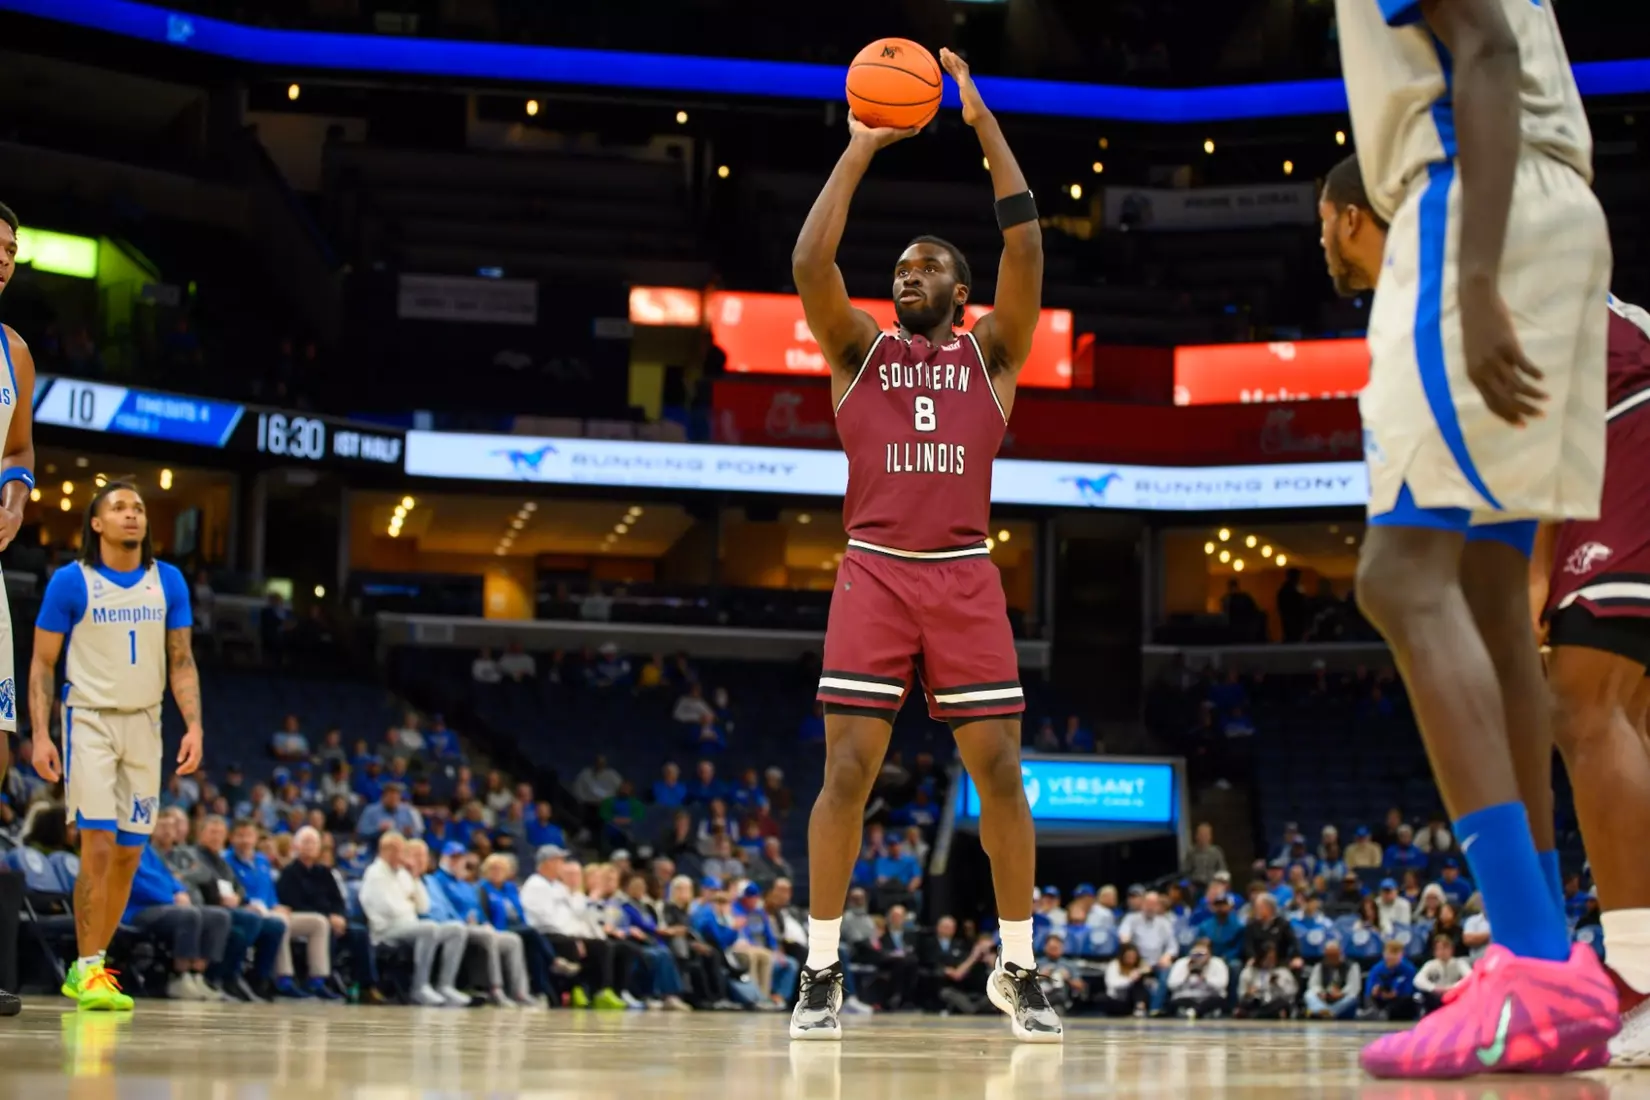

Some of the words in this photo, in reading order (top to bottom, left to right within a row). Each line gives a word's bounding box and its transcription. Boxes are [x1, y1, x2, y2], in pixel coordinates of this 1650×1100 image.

[878, 362, 970, 392] SOUTHERN
[69, 388, 95, 422] 10
[914, 395, 937, 432] 8
[257, 412, 326, 460] 16:30
[571, 452, 704, 472] RUNNING
[716, 457, 798, 477] PONY
[886, 442, 966, 475] ILLINOIS
[1134, 478, 1263, 495] RUNNING
[1273, 475, 1354, 491] PONY
[93, 605, 163, 624] Memphis
[128, 630, 137, 665] 1
[1047, 776, 1146, 796] VERSANT
